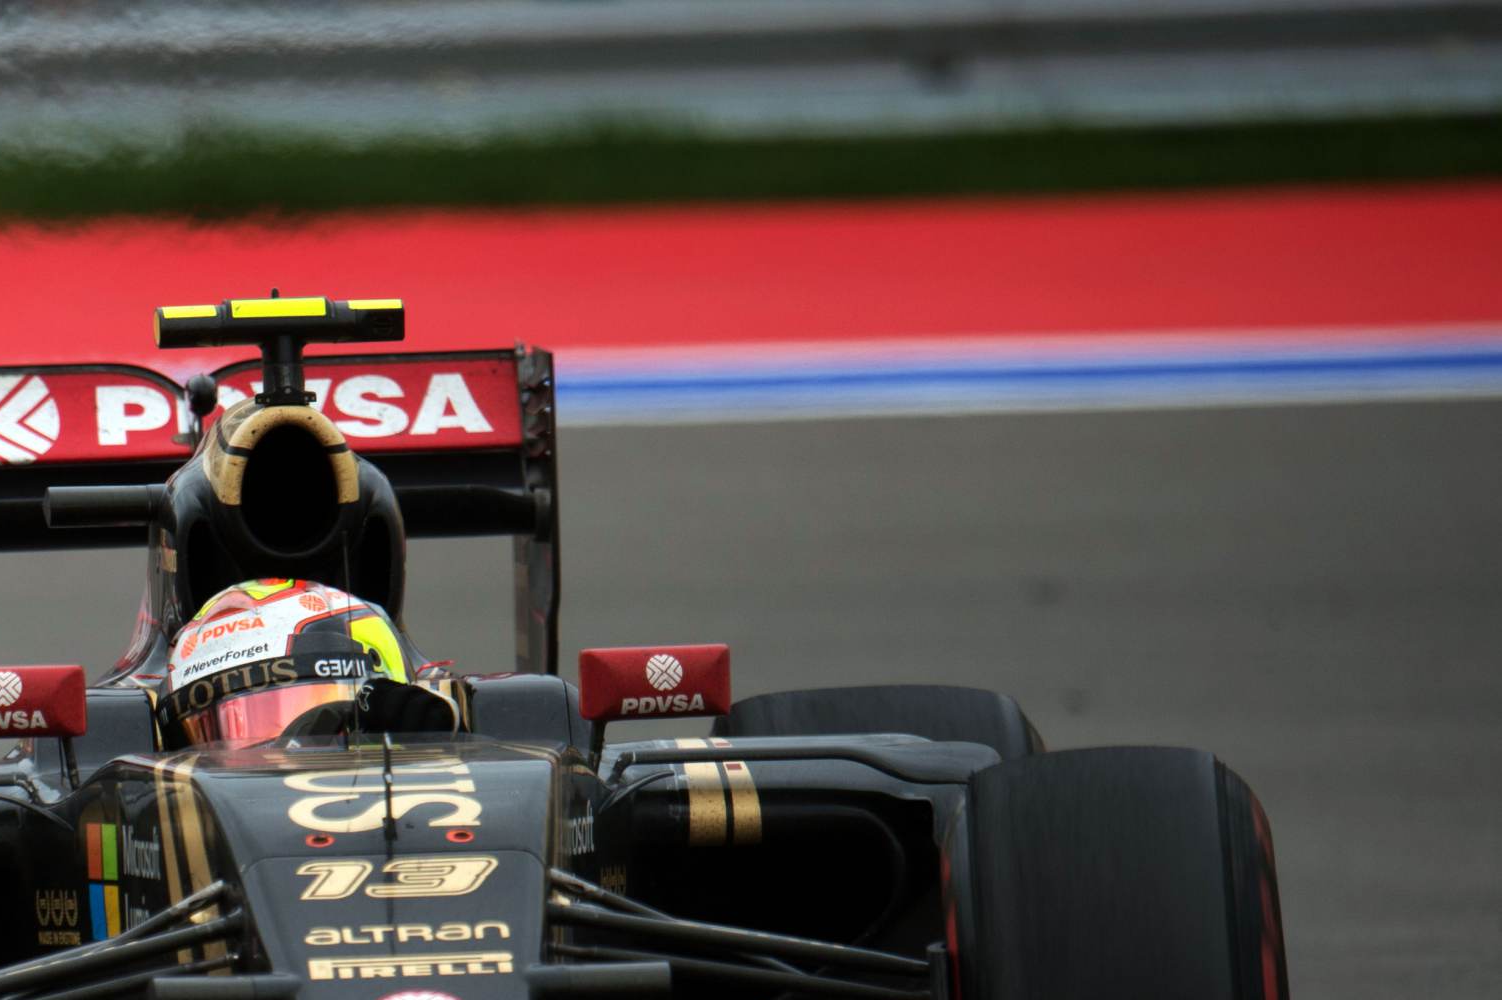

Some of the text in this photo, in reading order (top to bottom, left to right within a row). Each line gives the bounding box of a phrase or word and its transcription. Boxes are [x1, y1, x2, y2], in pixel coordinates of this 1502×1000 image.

[95, 372, 494, 446] PSA
[201, 617, 265, 644] PDVSA
[183, 643, 269, 677] #NeverForget
[172, 659, 298, 718] LOTUS
[620, 693, 705, 715] PDVSA
[297, 855, 499, 900] 13
[307, 952, 514, 980] PIRELLI
